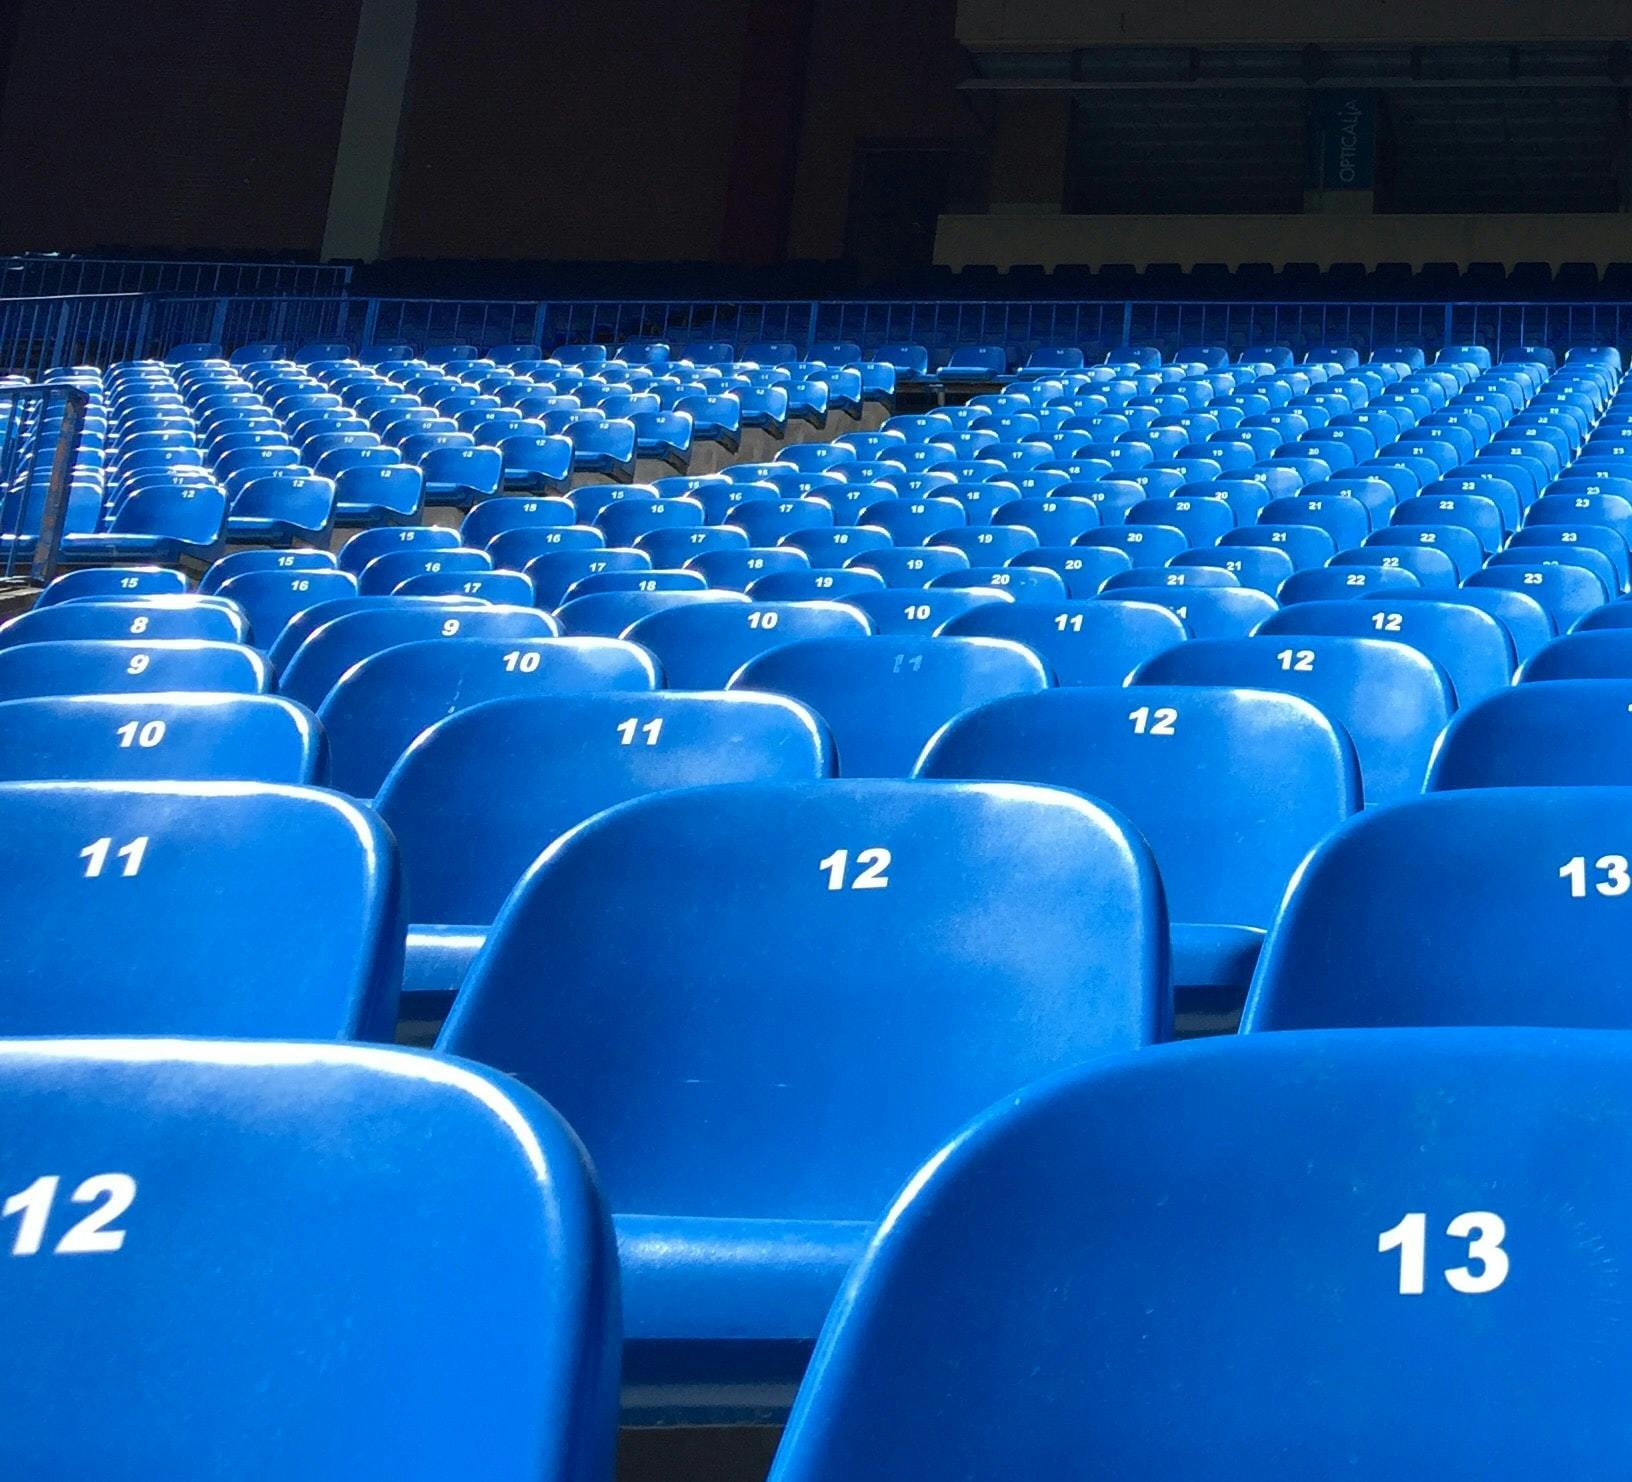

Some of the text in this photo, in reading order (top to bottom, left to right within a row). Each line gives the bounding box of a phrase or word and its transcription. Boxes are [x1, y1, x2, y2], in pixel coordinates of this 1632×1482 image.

[1043, 503, 1056, 512] 19
[1176, 502, 1190, 510] 20
[1309, 502, 1322, 510] 21
[1440, 501, 1454, 509] 22
[1576, 498, 1589, 507] 23
[651, 505, 664, 513] 16
[779, 504, 793, 512] 17
[911, 505, 924, 513] 18
[400, 532, 415, 540] 15
[547, 534, 561, 543] 16
[691, 534, 706, 543] 17
[834, 534, 848, 543] 18
[978, 534, 992, 543] 19
[1127, 533, 1143, 542] 20
[1272, 533, 1286, 541] 21
[1420, 533, 1436, 542] 22
[1562, 533, 1577, 541] 23
[278, 556, 294, 566] 15
[748, 559, 763, 568] 18
[907, 560, 923, 569] 19
[1065, 560, 1082, 569] 20
[1226, 561, 1242, 571] 21
[1382, 557, 1399, 567] 22
[425, 562, 440, 572] 16
[590, 562, 606, 572] 17
[121, 577, 139, 588] 15
[816, 577, 833, 587] 19
[991, 574, 1010, 585] 20
[1167, 574, 1184, 585] 21
[1347, 575, 1365, 585] 22
[1524, 573, 1542, 584] 23
[292, 580, 309, 591] 16
[464, 583, 481, 593] 17
[638, 580, 656, 591] 18
[905, 605, 930, 619] 10
[130, 617, 148, 633] 8
[748, 612, 778, 629] 10
[1055, 614, 1083, 631] 11
[1372, 612, 1402, 631] 12
[442, 619, 460, 636] 9
[127, 654, 150, 674] 9
[503, 651, 540, 672] 10
[1278, 650, 1315, 671] 12
[1129, 707, 1177, 735] 12
[117, 720, 166, 747] 10
[617, 718, 663, 745] 11
[80, 836, 149, 877] 11
[820, 848, 891, 890] 12
[1560, 855, 1630, 897] 13
[3, 1173, 136, 1255] 12
[1379, 1212, 1509, 1294] 13
